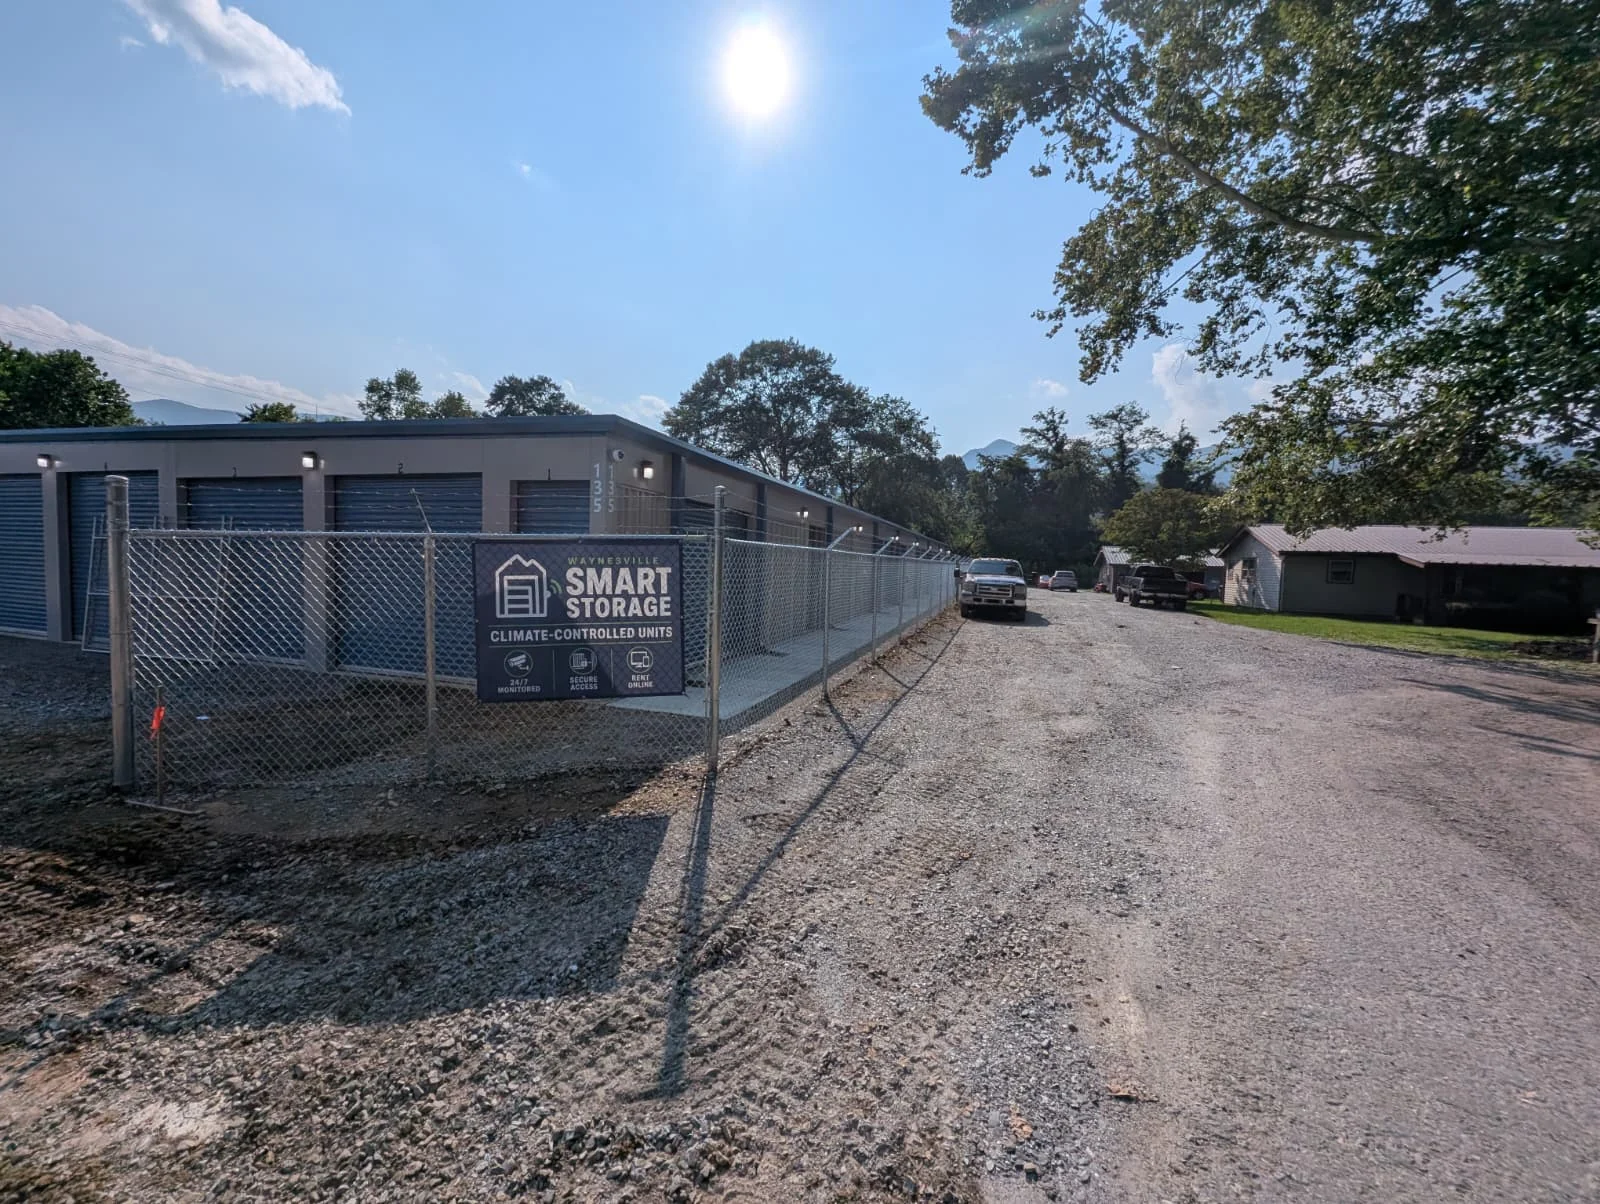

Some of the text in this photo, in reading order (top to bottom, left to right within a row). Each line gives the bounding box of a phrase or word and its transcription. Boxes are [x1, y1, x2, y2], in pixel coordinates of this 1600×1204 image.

[568, 556, 659, 565] WAYNESVILLE
[566, 567, 671, 595] SMART
[566, 597, 671, 618] STORAGE
[490, 627, 673, 642] CLIMATE-CONTROLLED UNITS
